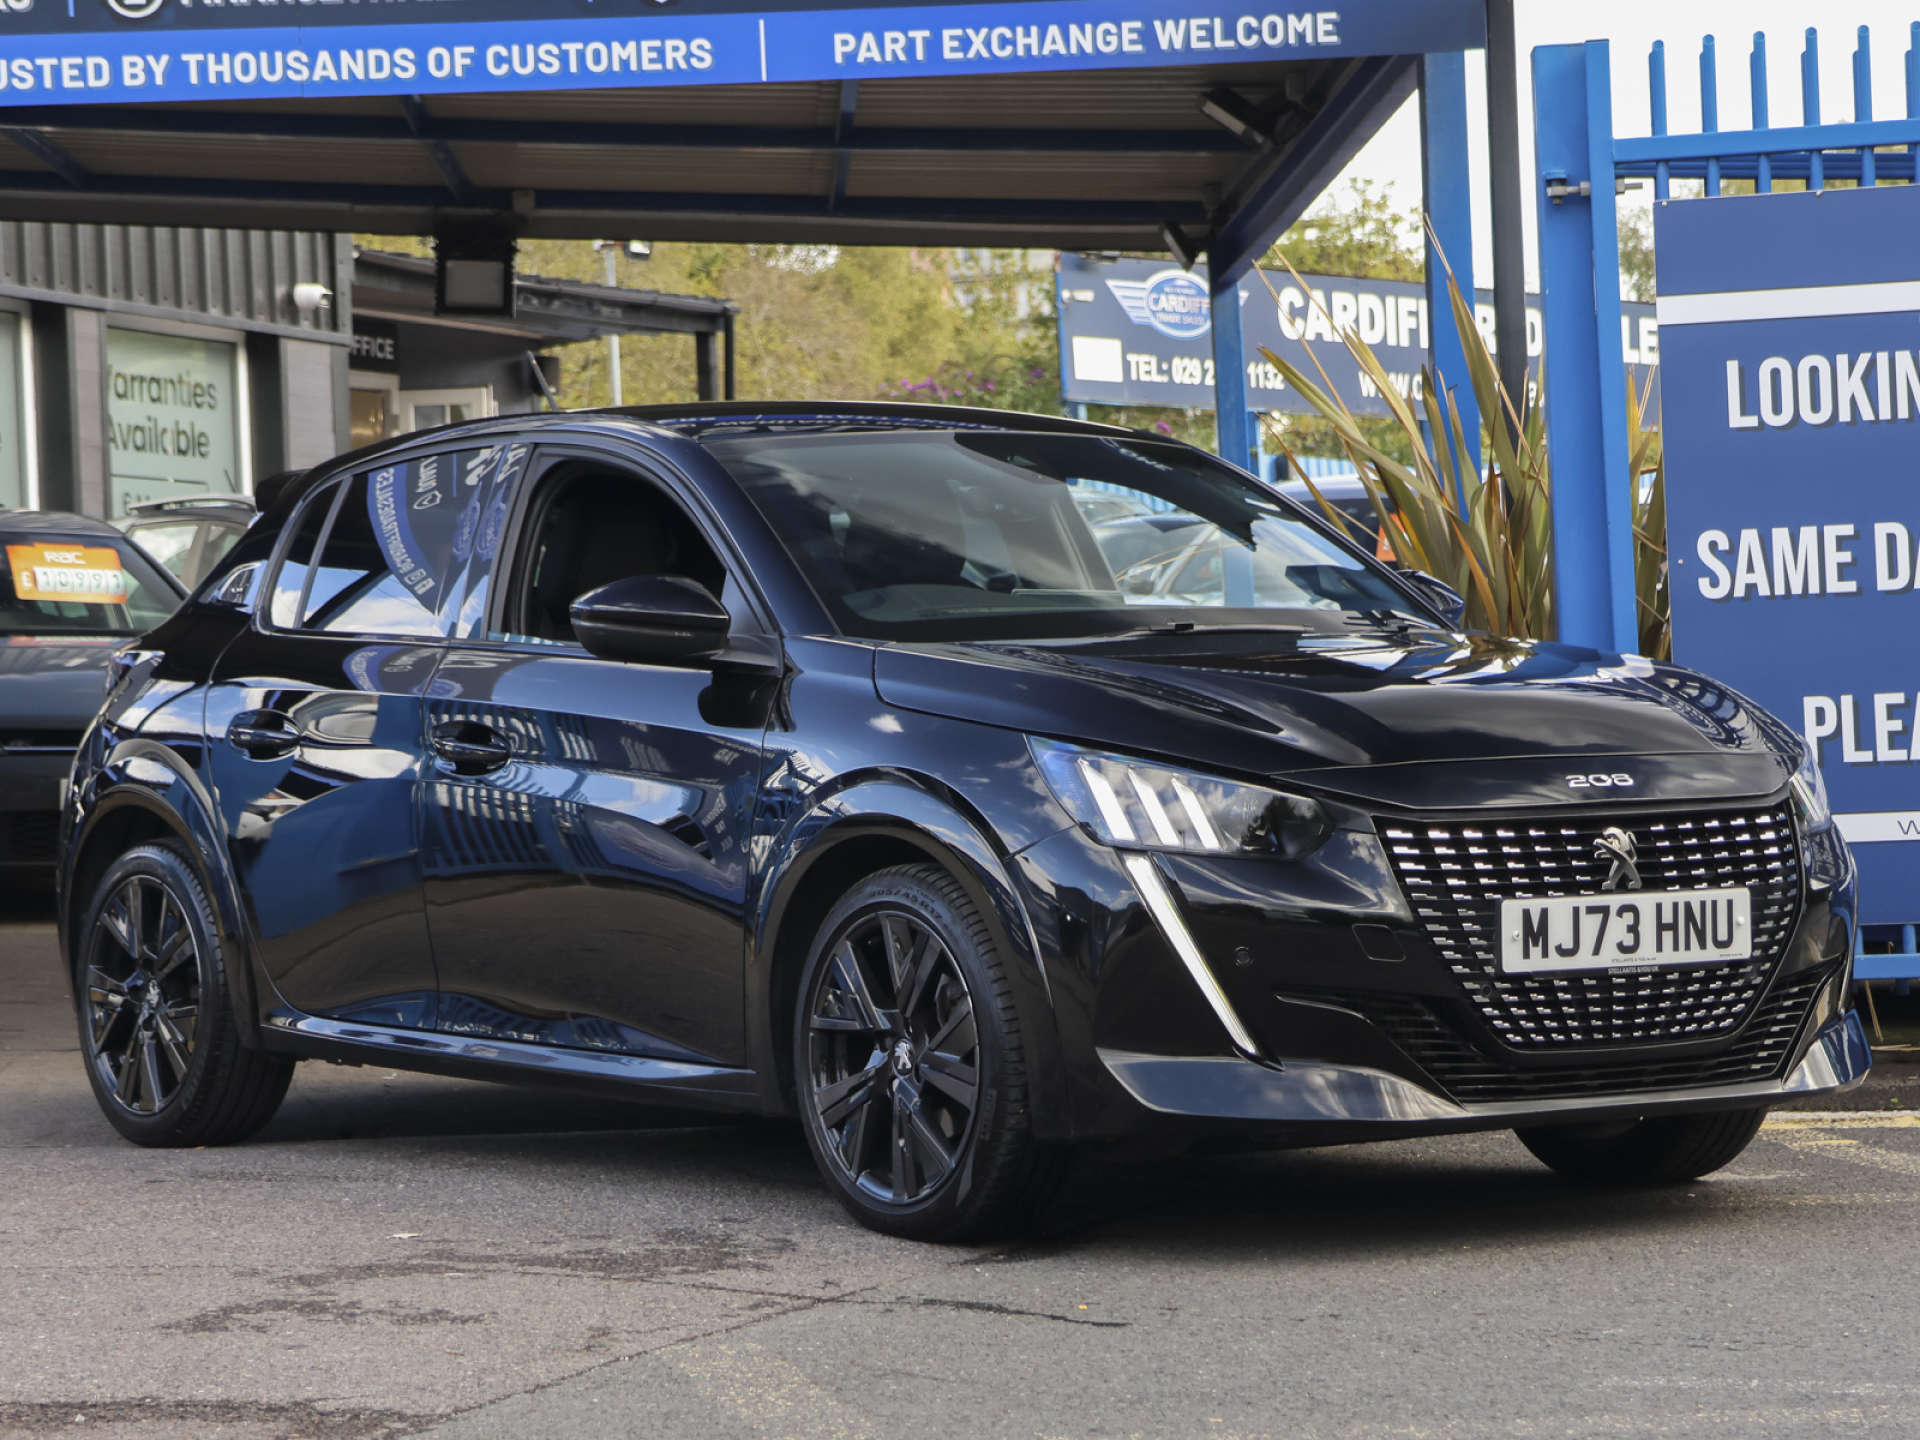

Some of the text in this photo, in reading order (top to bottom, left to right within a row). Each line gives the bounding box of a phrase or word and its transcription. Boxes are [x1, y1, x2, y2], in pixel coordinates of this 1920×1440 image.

[834, 12, 1338, 63] PART EXCHANGE WELCOME
[122, 54, 169, 87] BY
[181, 48, 416, 85] THOUSANDS
[427, 46, 475, 78] OF
[486, 38, 713, 76] CUSTOMERS
[352, 335, 395, 360] FFICE
[1127, 353, 1168, 383] TEL:
[1172, 356, 1200, 385] 029
[108, 366, 217, 410] arranties
[1697, 522, 1920, 599] SAME D
[1803, 691, 1920, 763] PLE
[1566, 774, 1634, 788] 208
[1522, 898, 1734, 960] MJ73 HNU
